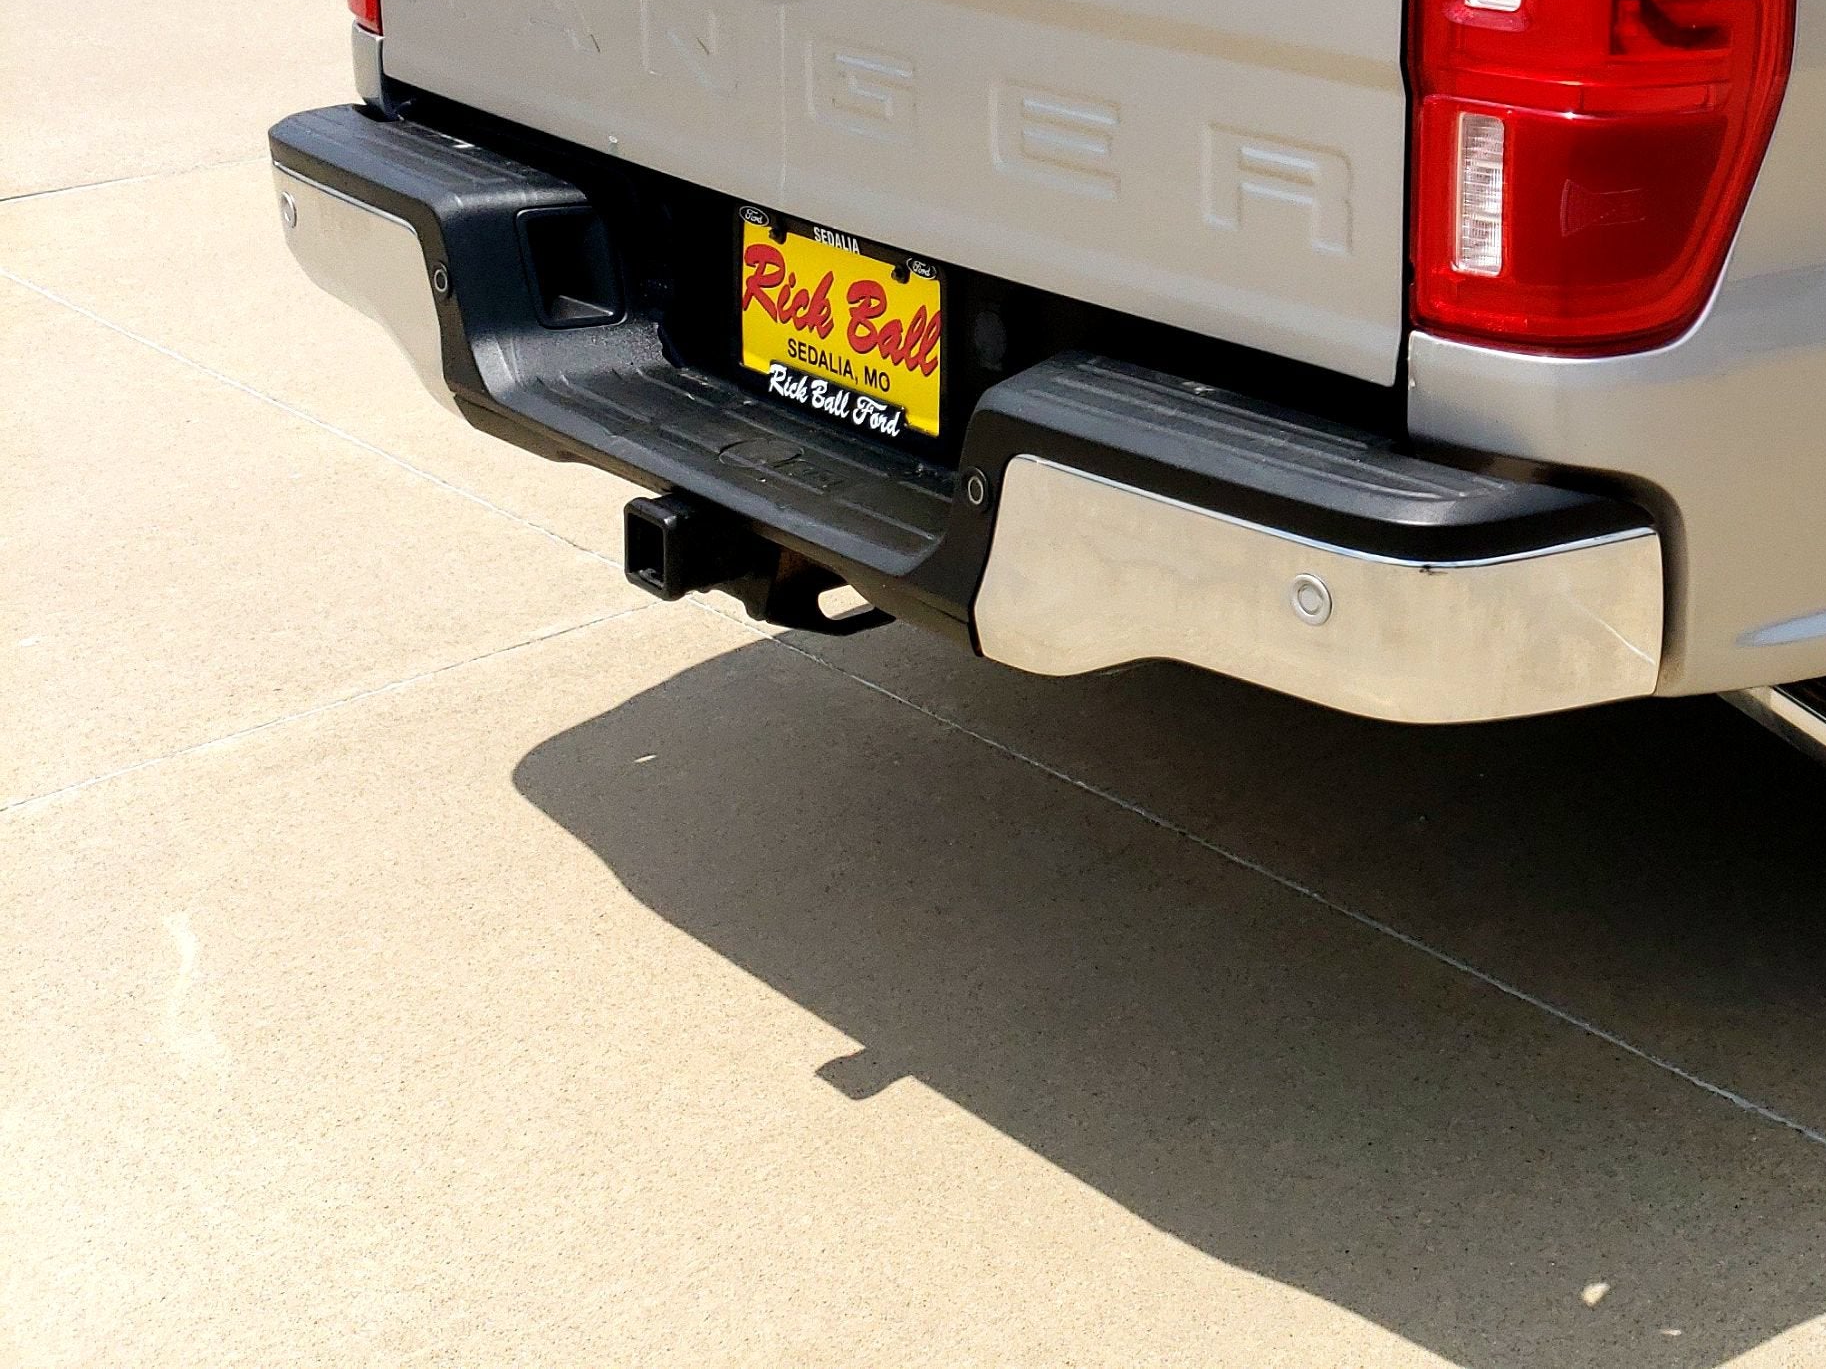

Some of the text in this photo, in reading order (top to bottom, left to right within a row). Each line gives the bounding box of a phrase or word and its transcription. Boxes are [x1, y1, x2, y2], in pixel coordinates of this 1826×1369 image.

[745, 208, 932, 277] Ford SEDALIA Ford
[743, 243, 942, 377] Rick Ball
[769, 363, 902, 437] Rick Ball Ford
[787, 337, 891, 393] SEDALIA, MO
